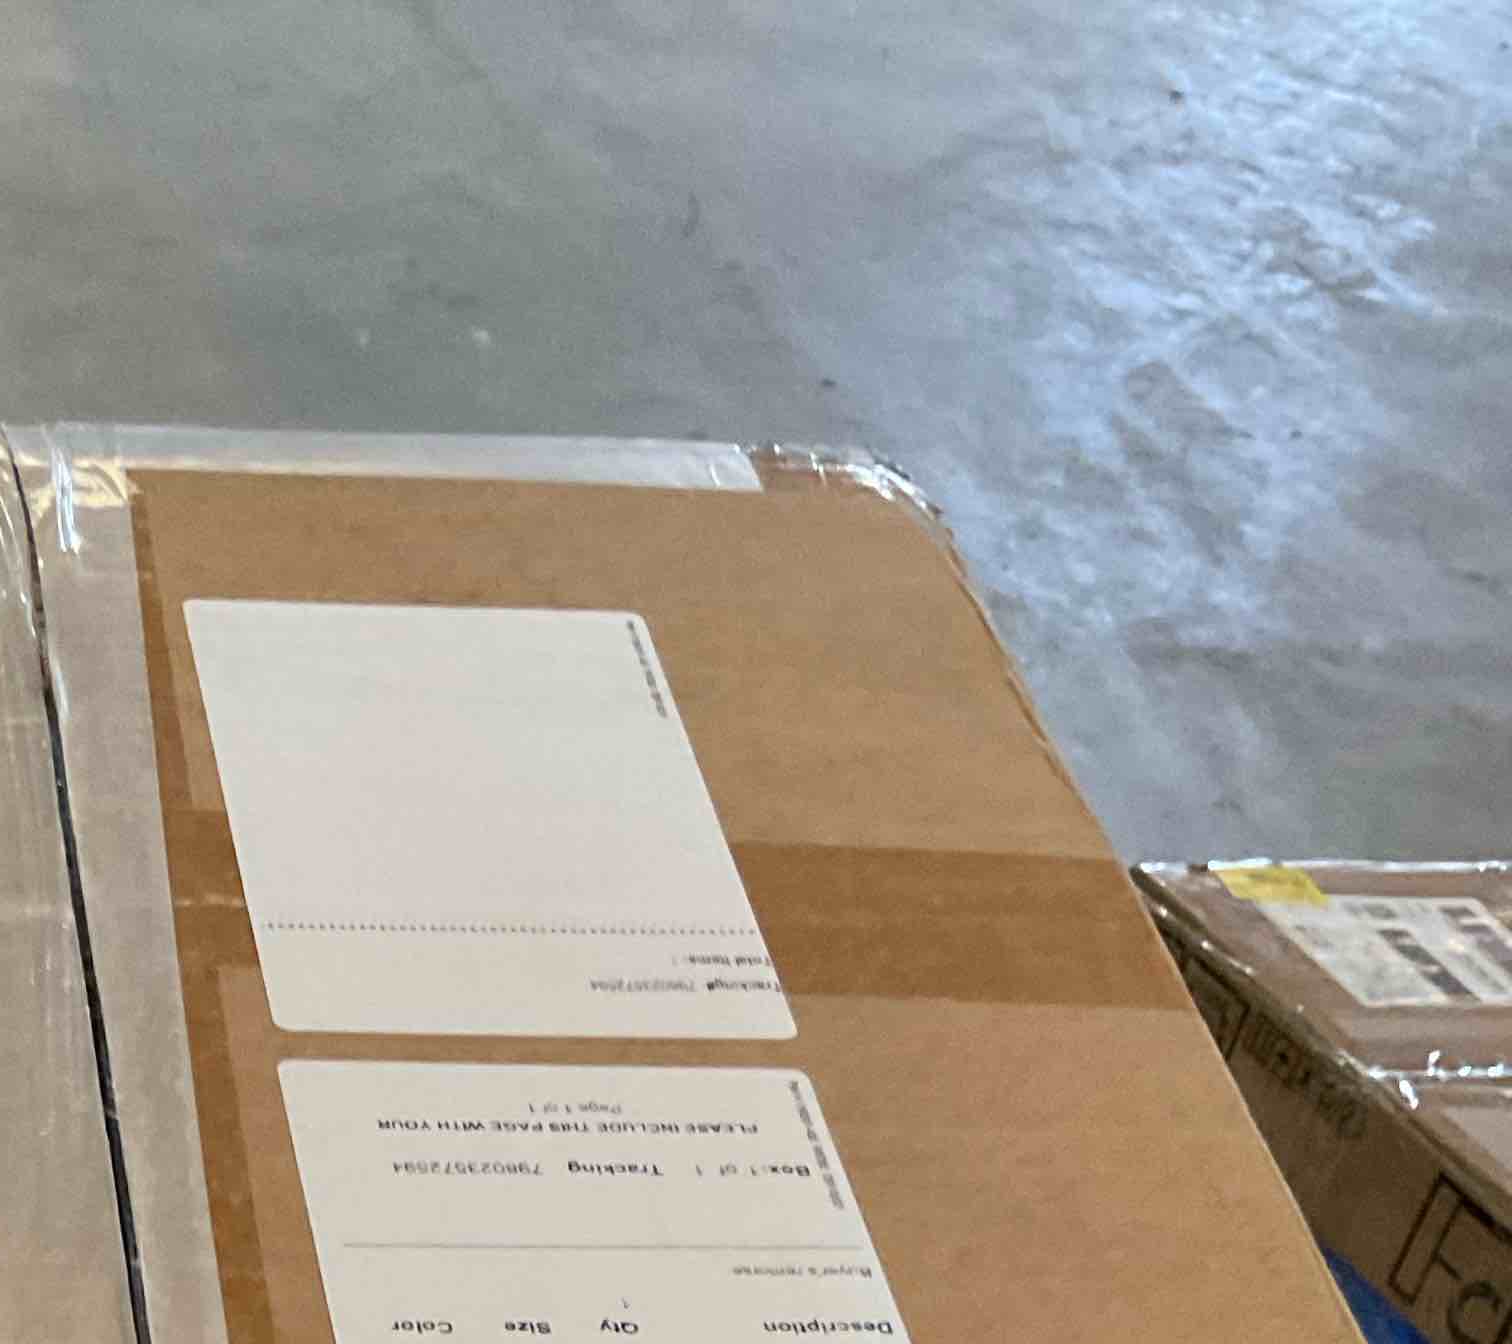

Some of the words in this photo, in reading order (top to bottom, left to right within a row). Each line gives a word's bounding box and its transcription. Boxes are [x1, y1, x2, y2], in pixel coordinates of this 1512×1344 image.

[376, 1120, 432, 1134] YOUR
[436, 1121, 486, 1134] WITH
[491, 1121, 544, 1134] PAGE
[549, 1121, 590, 1134] THIS
[595, 1121, 679, 1134] INCLUDE
[684, 1121, 759, 1135] PLEASE
[567, 1161, 664, 1177] Tracking
[391, 1320, 453, 1335] Color
[504, 1321, 552, 1335] Size
[600, 1318, 639, 1335] Qty
[763, 1319, 893, 1336] Description
